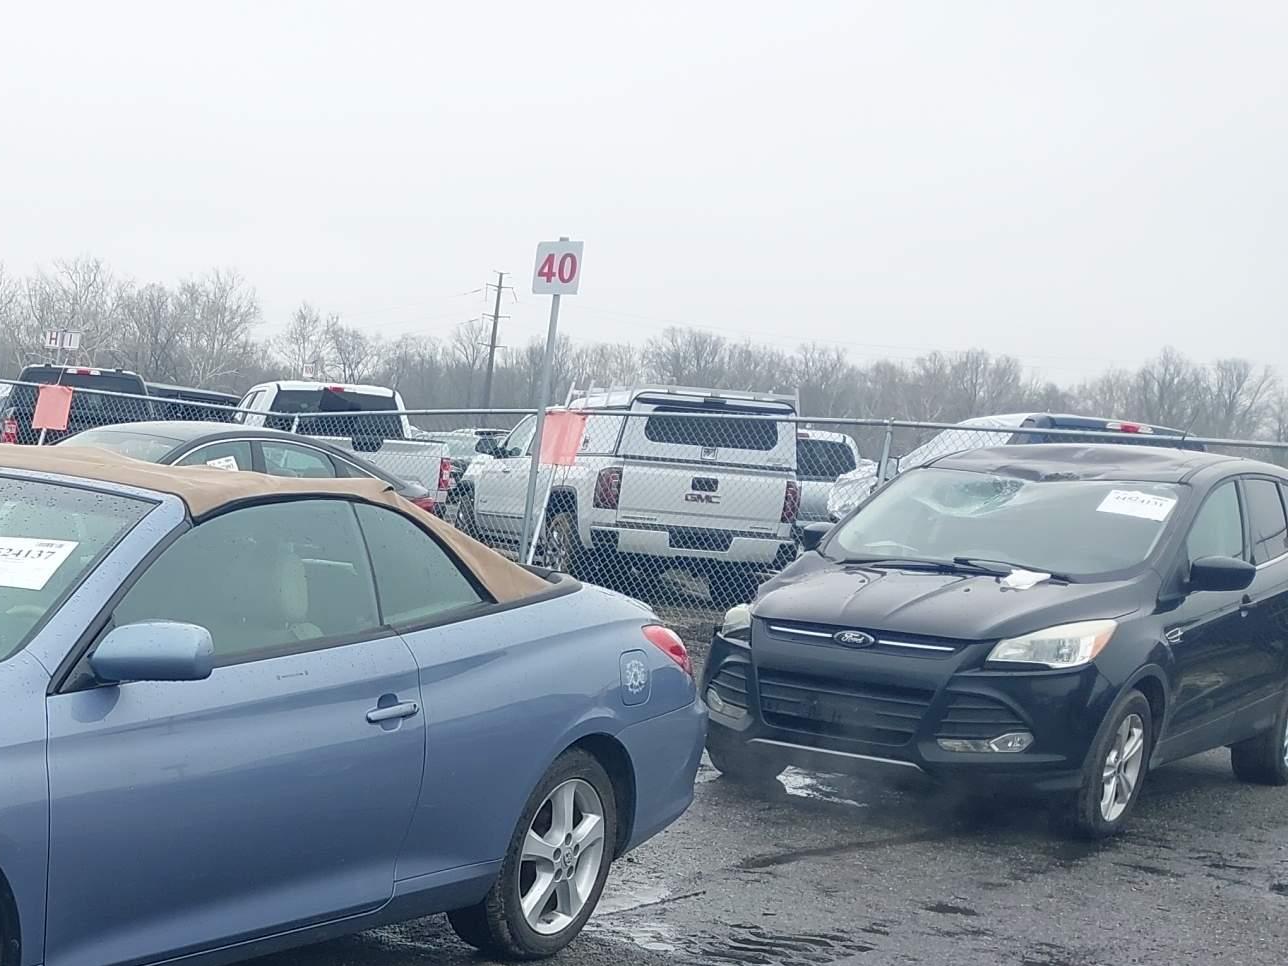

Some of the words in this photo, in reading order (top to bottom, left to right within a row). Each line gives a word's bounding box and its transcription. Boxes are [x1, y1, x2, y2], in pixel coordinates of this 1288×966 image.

[537, 252, 578, 284] 40
[49, 331, 58, 345] H
[684, 493, 721, 505] GMC
